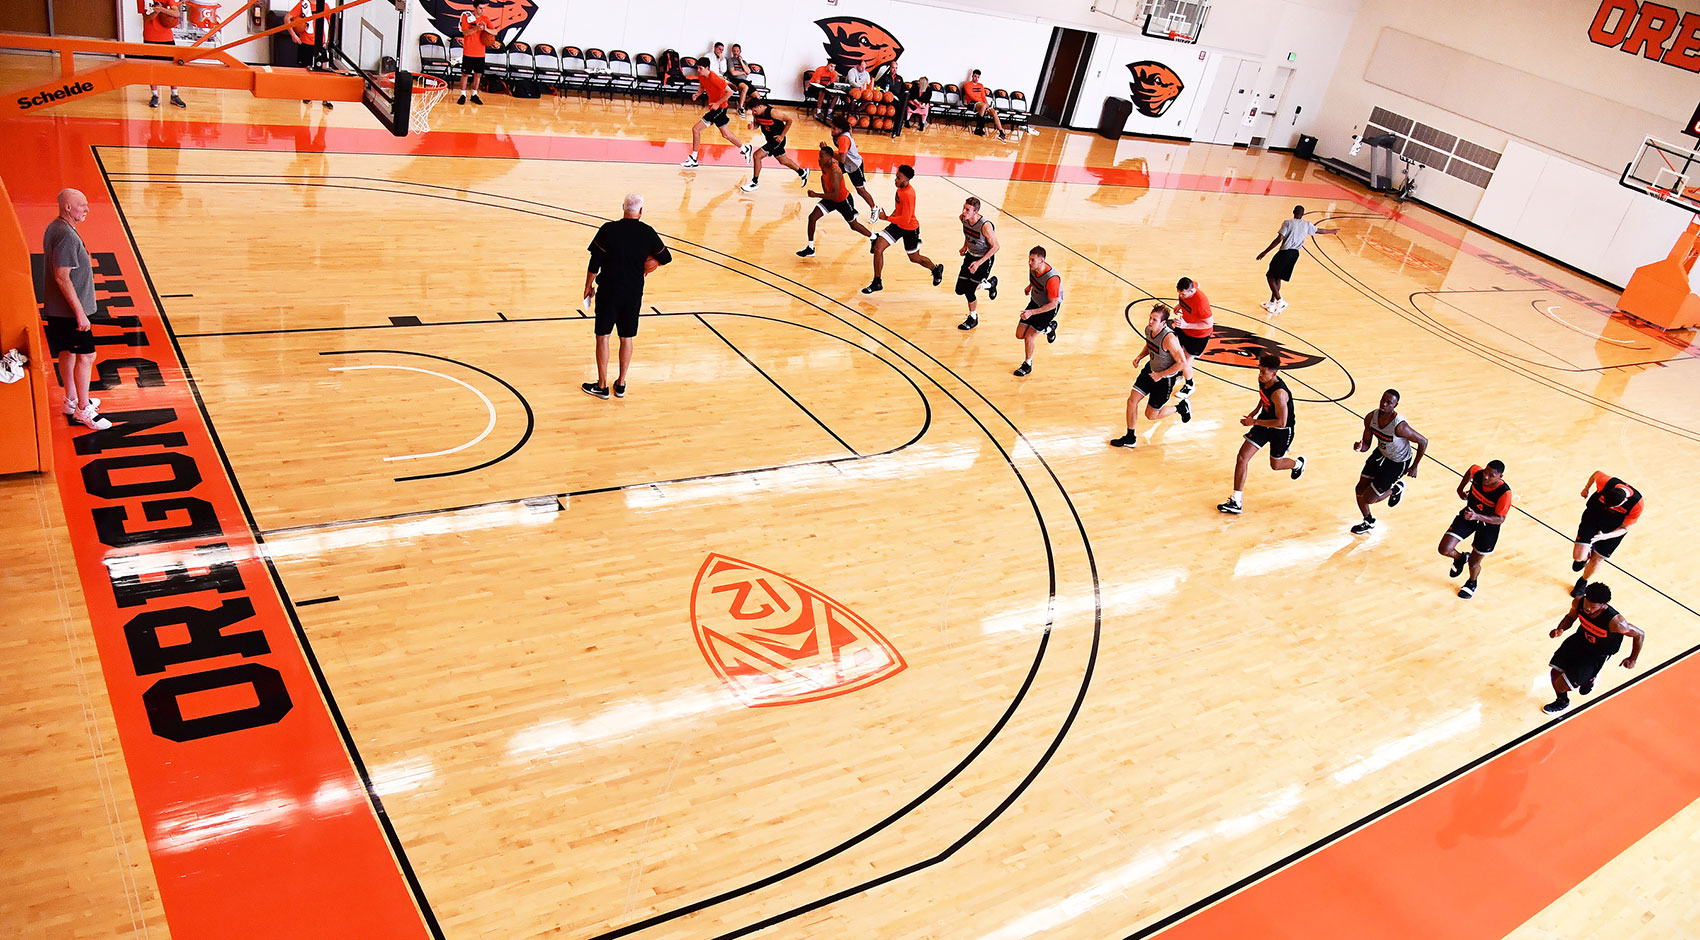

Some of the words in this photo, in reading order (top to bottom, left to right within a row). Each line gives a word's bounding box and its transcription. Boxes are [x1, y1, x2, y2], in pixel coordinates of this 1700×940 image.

[203, 8, 211, 18] G
[17, 81, 94, 109] Schelde
[67, 408, 293, 742] OREGON
[711, 577, 792, 621] 12
